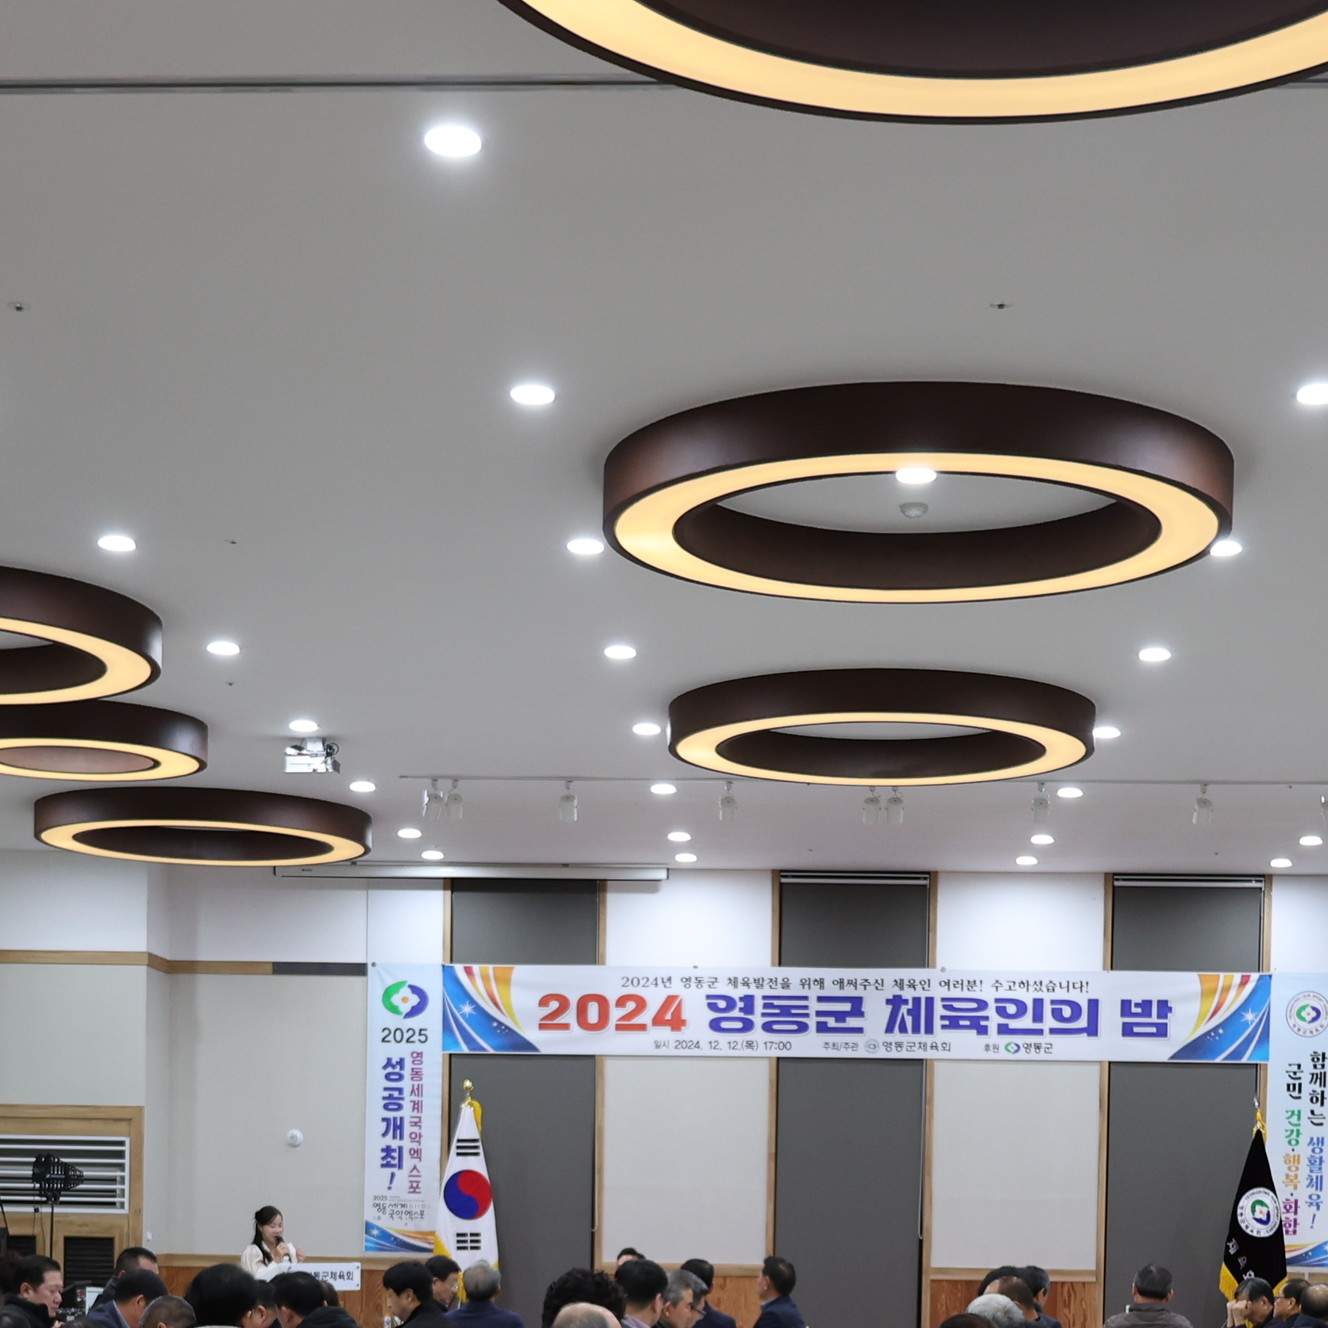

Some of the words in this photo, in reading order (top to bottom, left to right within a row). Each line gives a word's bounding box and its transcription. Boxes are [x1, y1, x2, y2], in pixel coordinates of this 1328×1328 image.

[621, 975, 673, 988] 2024년
[680, 976, 719, 990] 영동군
[727, 976, 792, 990] 체육발전을
[799, 977, 825, 991] 위해
[831, 977, 885, 991] 애써주신
[892, 978, 932, 992] 체육인
[938, 979, 984, 992] 여러분!
[537, 993, 687, 1033] 2024
[705, 994, 866, 1035] 영동군
[884, 994, 1099, 1038] 체육인의
[1120, 999, 1173, 1038] 밤
[381, 1027, 429, 1044] 2025
[653, 1040, 670, 1050] 일시
[674, 1039, 703, 1051] 2024.
[708, 1040, 723, 1052] 12.
[763, 1041, 792, 1051] 17:00
[823, 1041, 859, 1052] 주최/주관
[882, 1041, 952, 1053] 영동군체육회
[983, 1043, 1001, 1054] 후원
[1023, 1043, 1054, 1055] 영동군
[1285, 1063, 1304, 1101] 군민
[1307, 1051, 1328, 1127] 함께하는
[379, 1057, 406, 1191] 성공개최!
[408, 1051, 424, 1195] 영동세계국악엑스포
[1305, 1136, 1327, 1230] 생활체육!
[310, 1270, 354, 1282] 동군체육회
